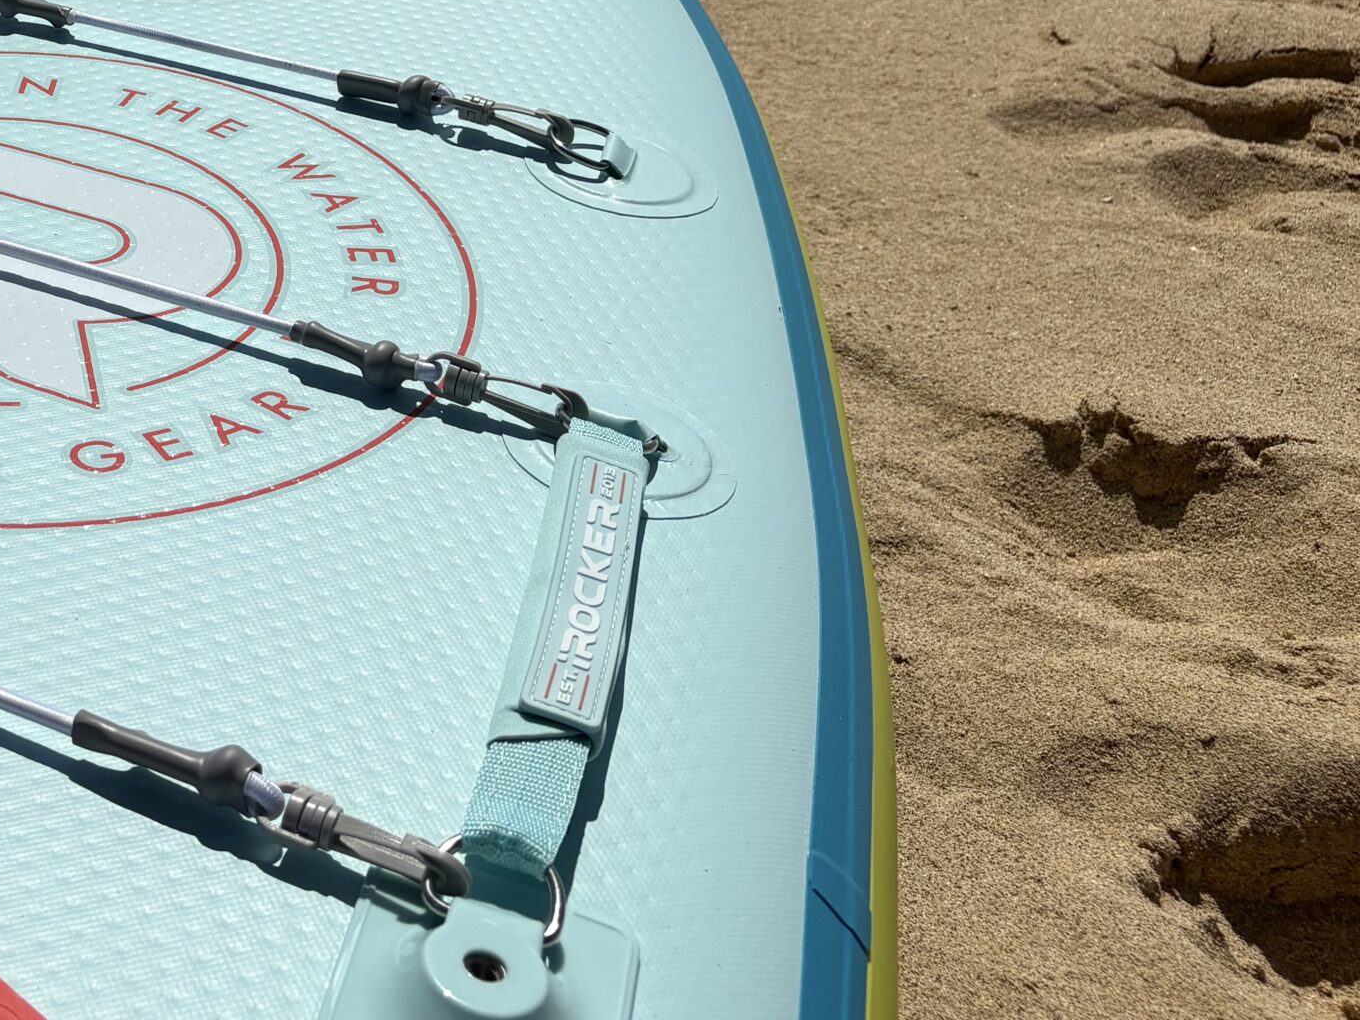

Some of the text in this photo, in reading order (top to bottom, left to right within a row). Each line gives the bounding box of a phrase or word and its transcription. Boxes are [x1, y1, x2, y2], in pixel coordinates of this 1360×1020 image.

[118, 88, 247, 140] THE
[278, 153, 401, 296] WATER
[69, 391, 309, 474] GEAR
[555, 668, 580, 704] EST.
